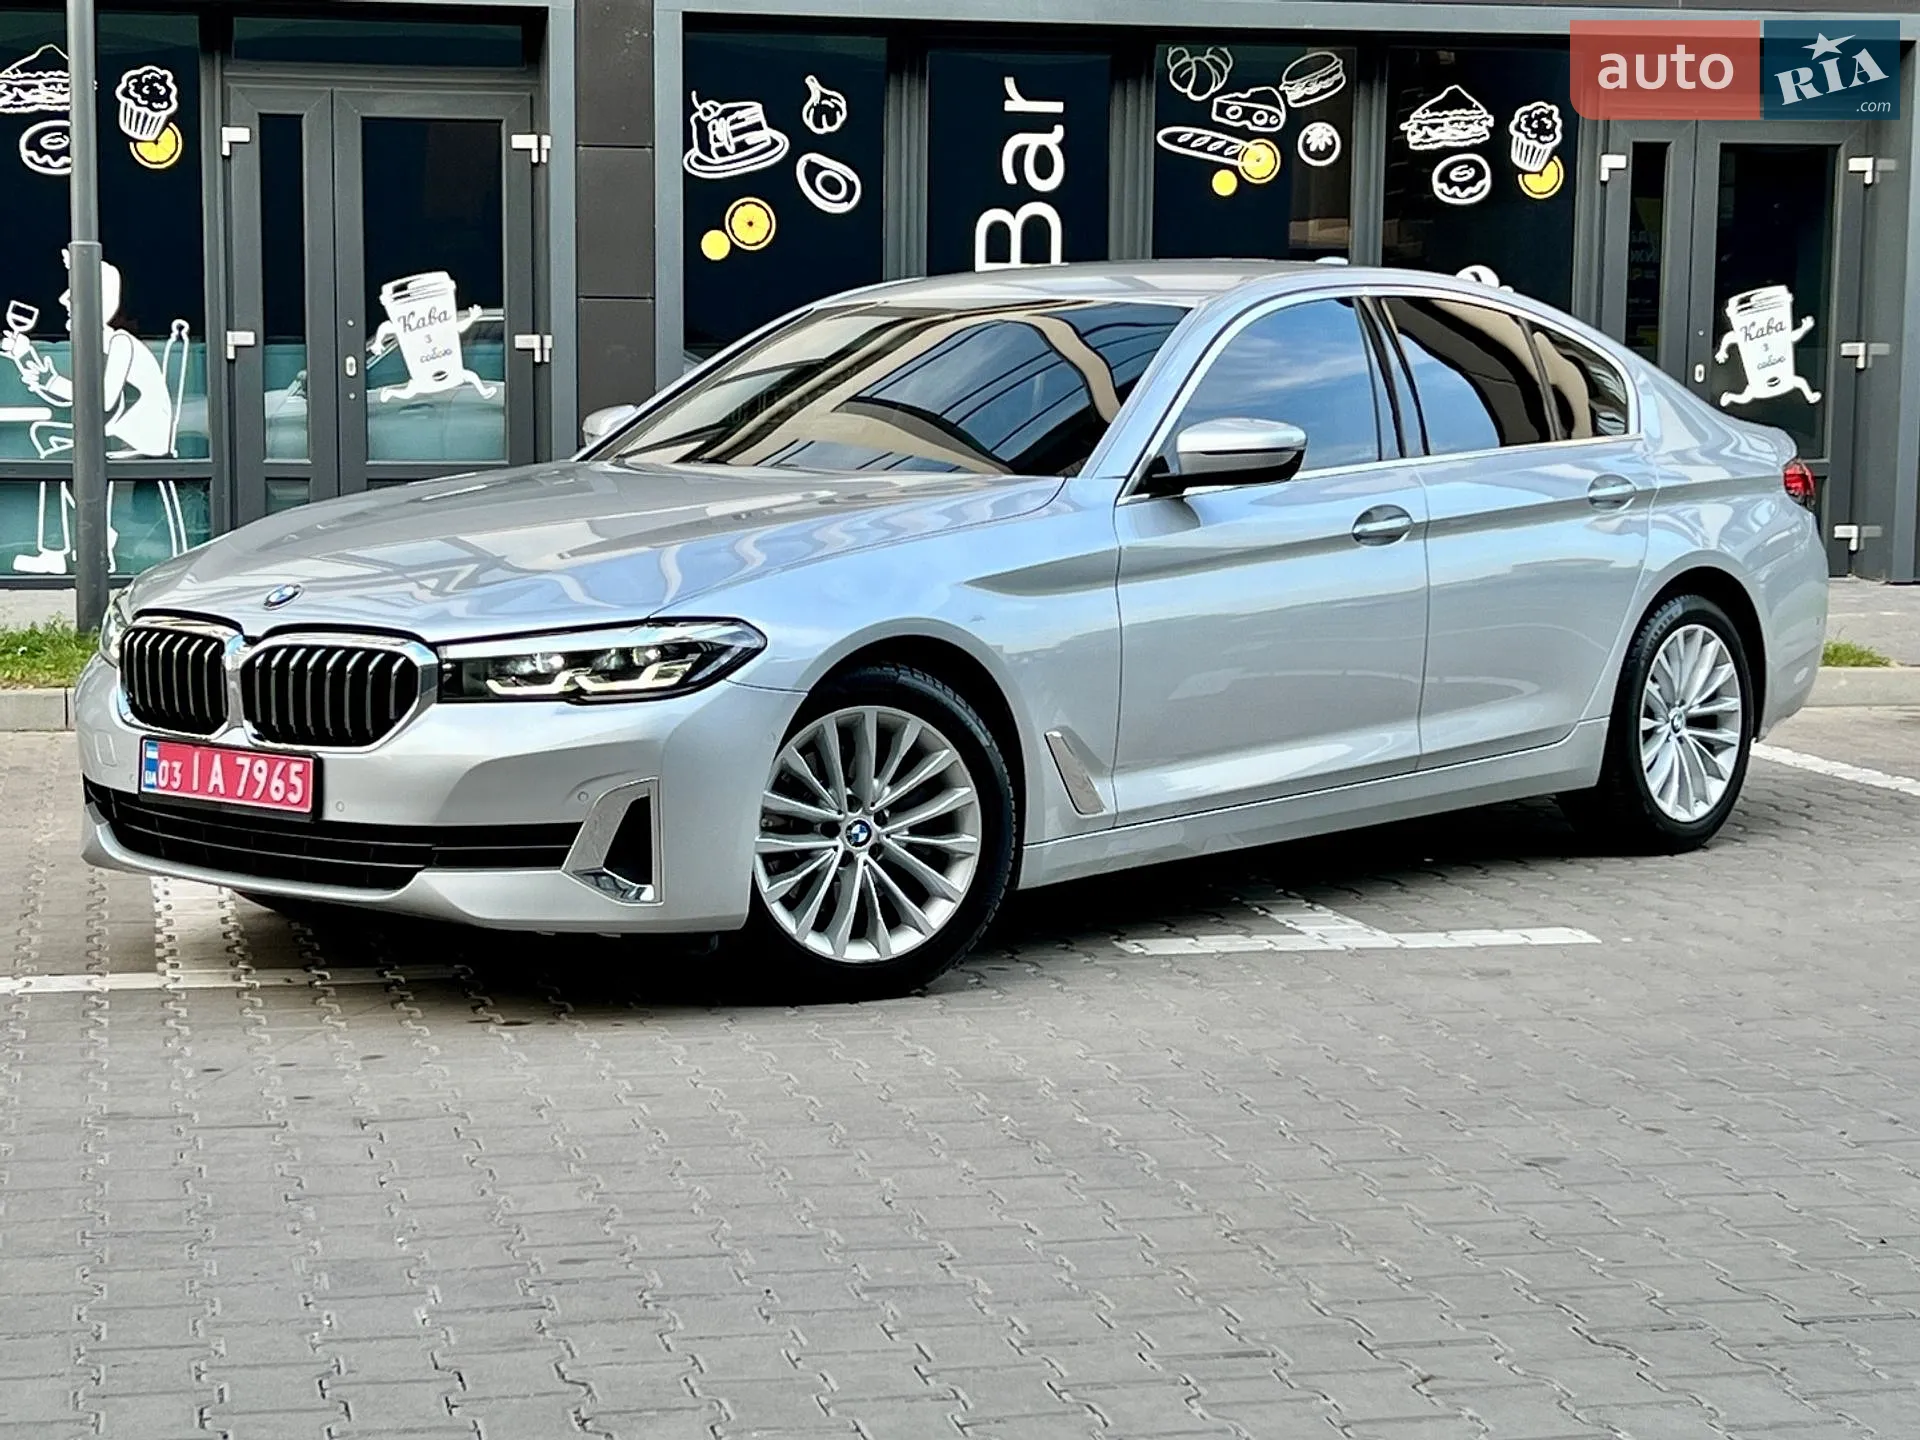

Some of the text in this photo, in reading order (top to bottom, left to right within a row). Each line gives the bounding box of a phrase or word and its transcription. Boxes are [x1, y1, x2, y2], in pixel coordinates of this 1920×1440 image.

[974, 76, 1066, 272] Bar
[397, 306, 452, 333] Кава
[1740, 317, 1787, 342] Кава
[157, 759, 184, 790] 03
[235, 756, 305, 805] 7965
